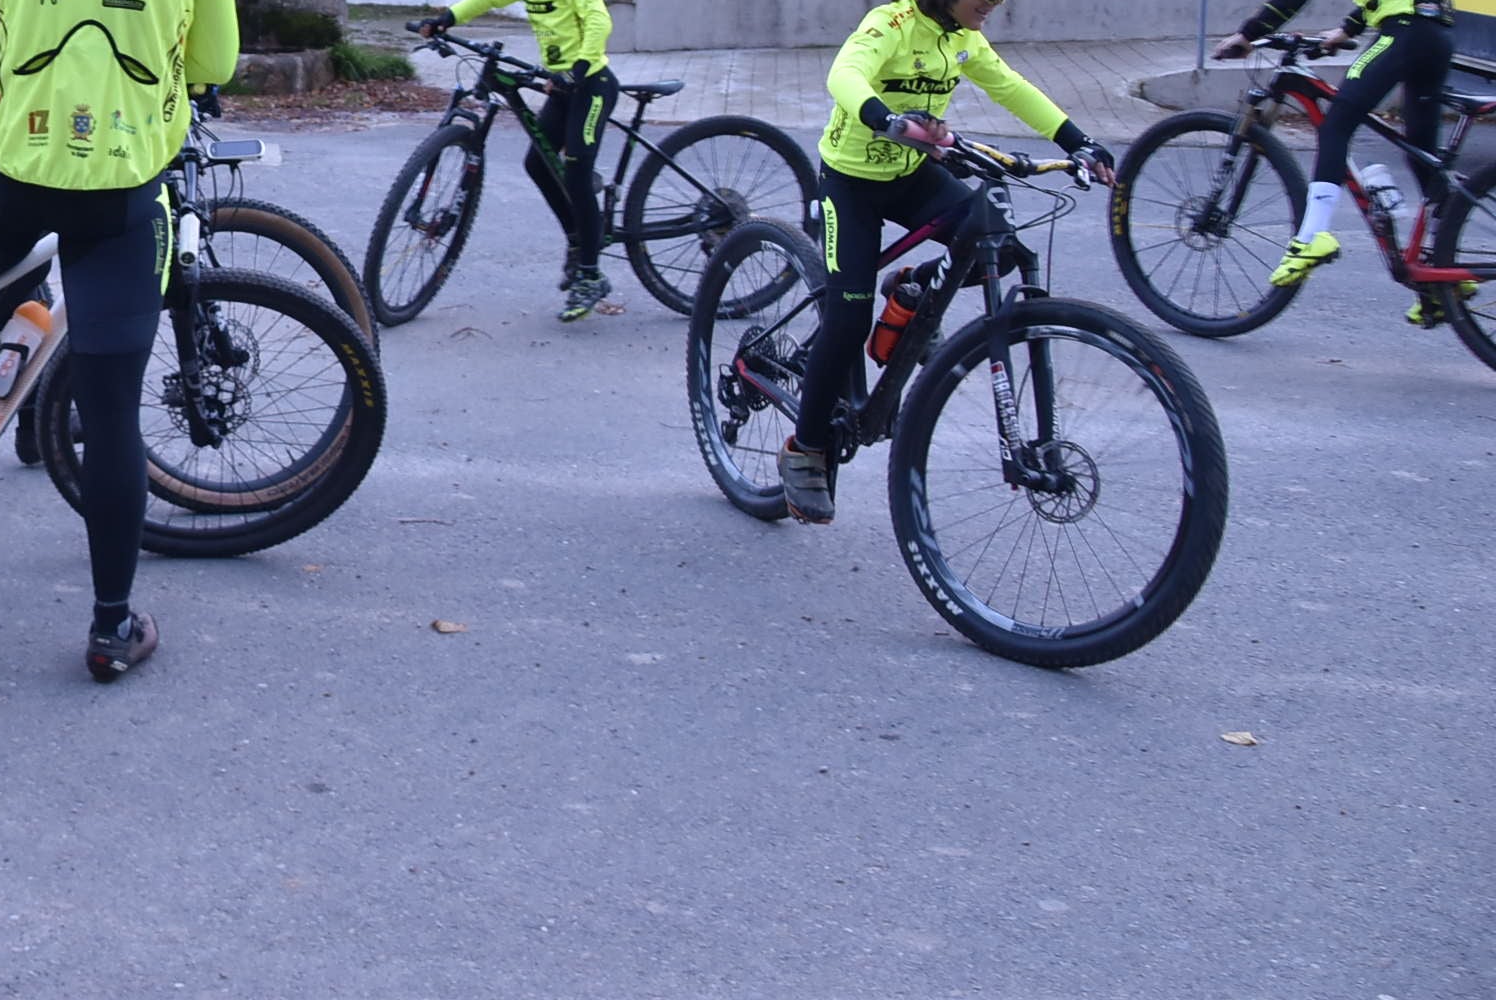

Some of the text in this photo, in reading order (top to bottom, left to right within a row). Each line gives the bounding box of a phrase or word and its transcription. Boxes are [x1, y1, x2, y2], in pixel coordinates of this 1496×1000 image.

[826, 209, 835, 259] ALJOMAR
[340, 342, 375, 408] MAXXIS
[907, 540, 964, 616] MAXXIS
